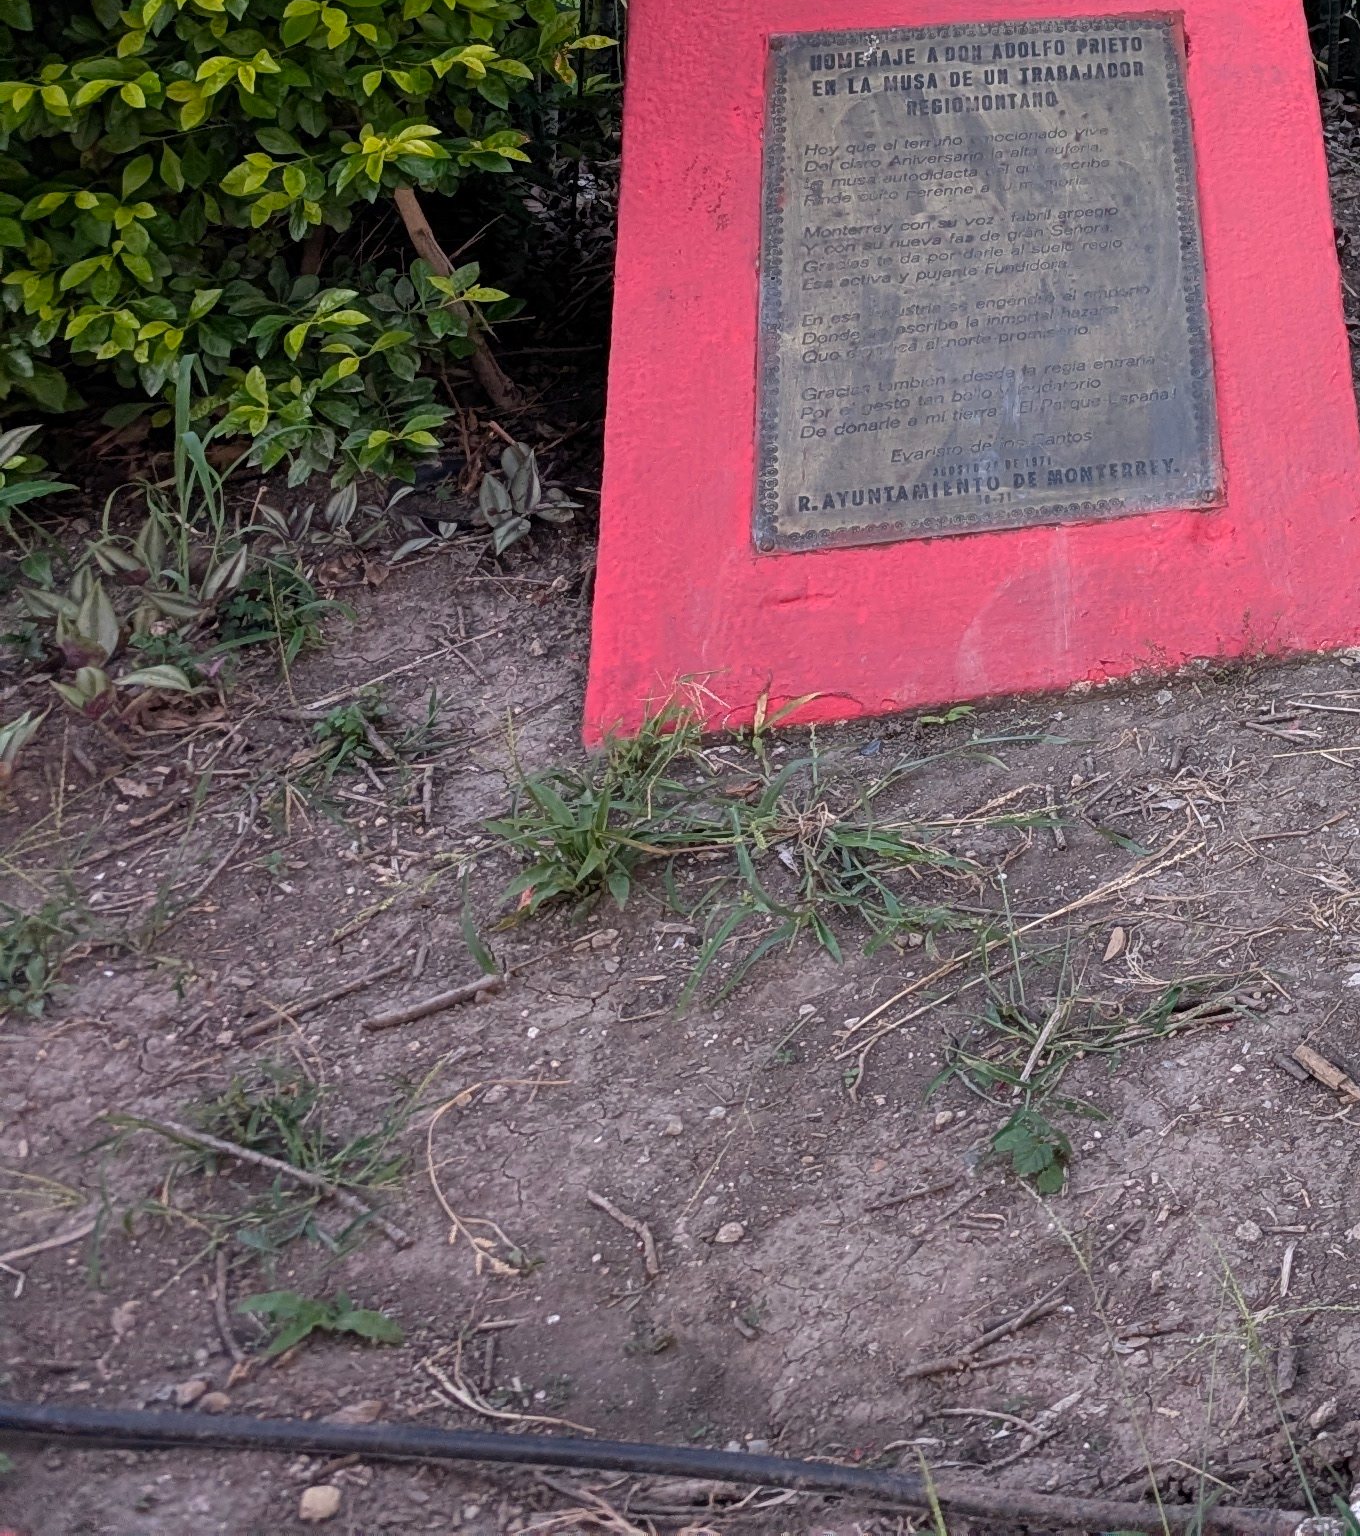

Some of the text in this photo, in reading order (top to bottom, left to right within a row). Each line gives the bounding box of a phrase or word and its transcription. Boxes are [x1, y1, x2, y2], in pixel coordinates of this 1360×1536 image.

[810, 36, 1143, 72] HOMENAJE A DON ADOLFO PRIETO
[812, 61, 1145, 97] EN LA MUSA DE UN TRABAJADOR
[906, 91, 1059, 116] REGIOMONTANO
[804, 144, 840, 158] Hoy
[845, 142, 876, 156] que
[883, 139, 897, 152] el
[803, 159, 833, 173] Del
[804, 222, 893, 240] Monterrey
[900, 220, 931, 232] con
[937, 218, 957, 229] su
[964, 215, 994, 226] voz
[801, 243, 818, 256] Y
[889, 235, 942, 249] nueva
[980, 230, 1000, 242] de
[900, 251, 920, 265] da
[927, 250, 954, 264] por
[839, 273, 892, 288] activa
[899, 271, 909, 284] y
[802, 314, 823, 328] En
[966, 316, 979, 329] la
[800, 406, 832, 420] Por
[800, 425, 827, 440] De
[834, 417, 901, 437] donarle
[908, 416, 918, 427] a
[1013, 471, 1037, 489] DE
